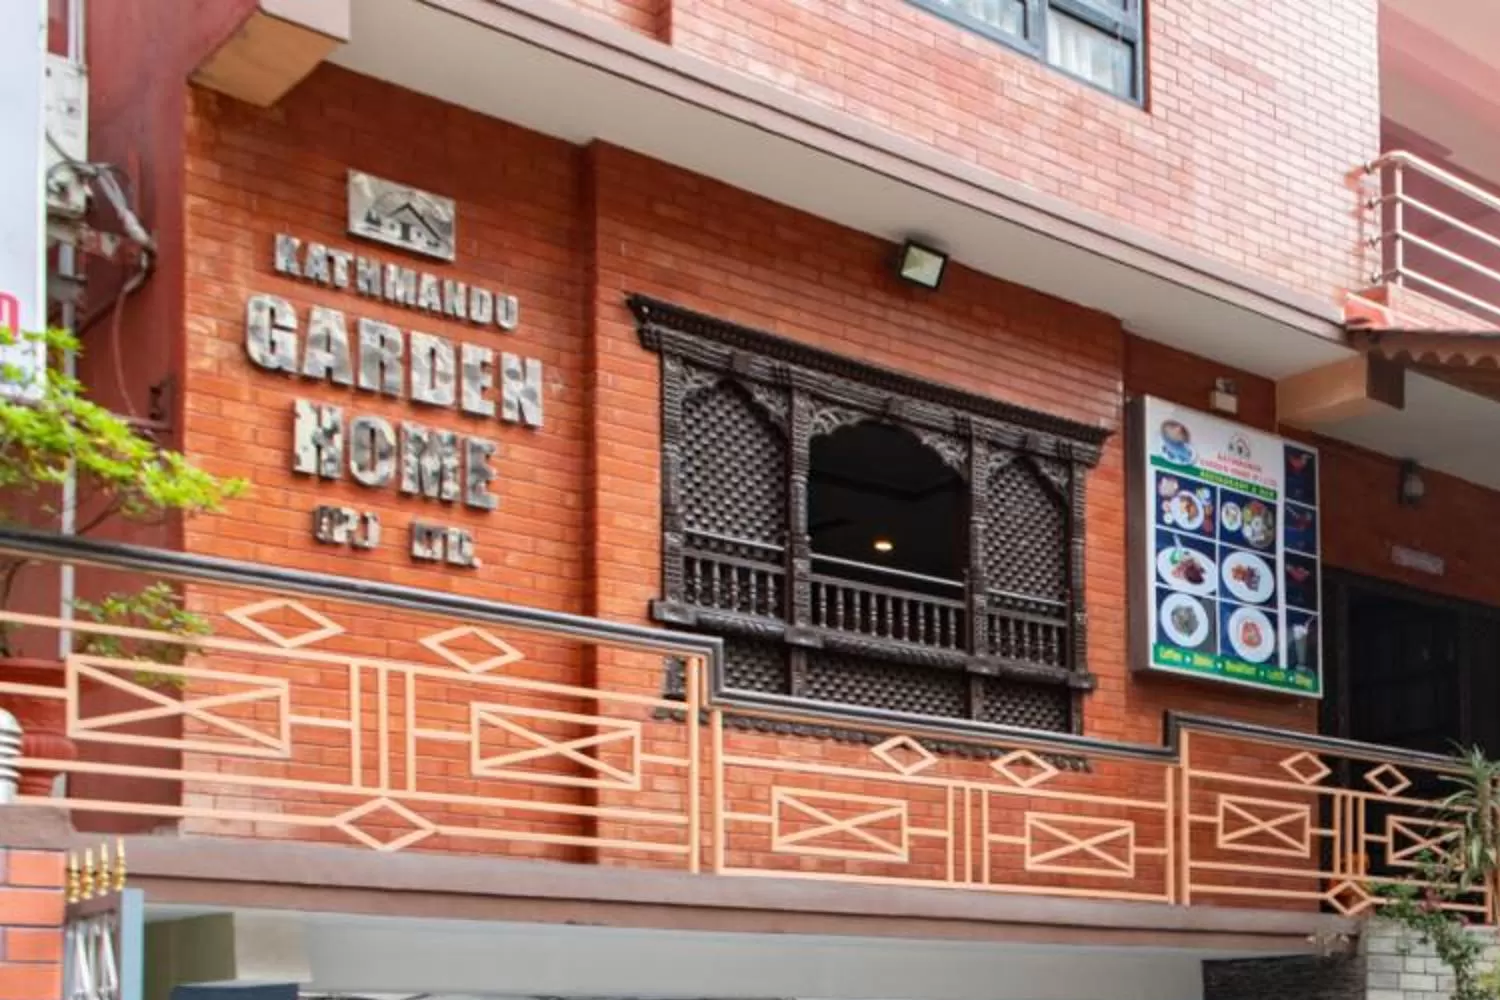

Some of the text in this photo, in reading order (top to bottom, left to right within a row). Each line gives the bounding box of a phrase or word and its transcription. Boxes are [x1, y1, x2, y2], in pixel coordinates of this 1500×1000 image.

[275, 233, 519, 330] KATHMANDU
[246, 294, 544, 428] GARDEN
[293, 399, 499, 510] HOME
